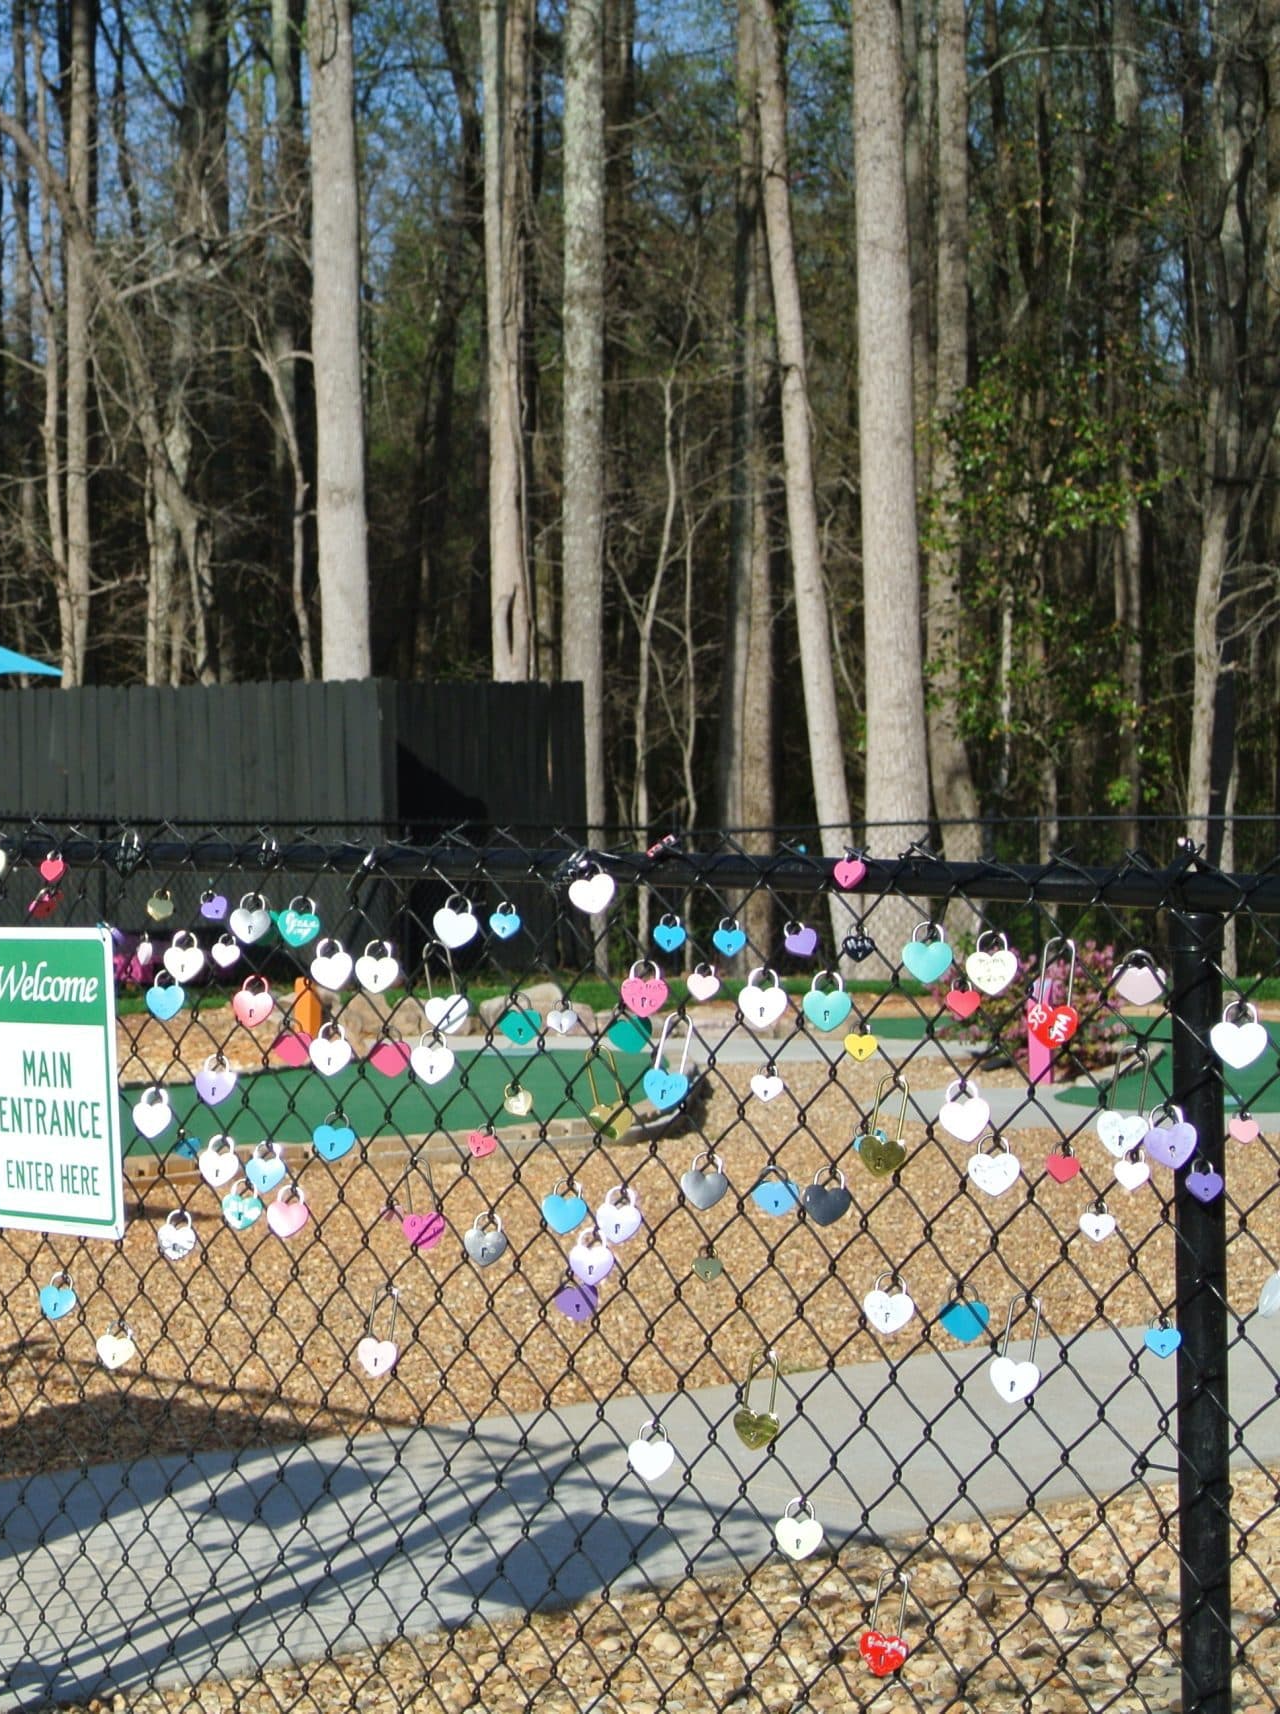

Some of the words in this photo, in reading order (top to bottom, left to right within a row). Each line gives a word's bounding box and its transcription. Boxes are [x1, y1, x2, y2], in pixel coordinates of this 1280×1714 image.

[23, 1050, 72, 1090] MAIN
[0, 1096, 103, 1140] ENTRANCE
[6, 1159, 54, 1194] ENTER
[60, 1163, 100, 1197] HERE
